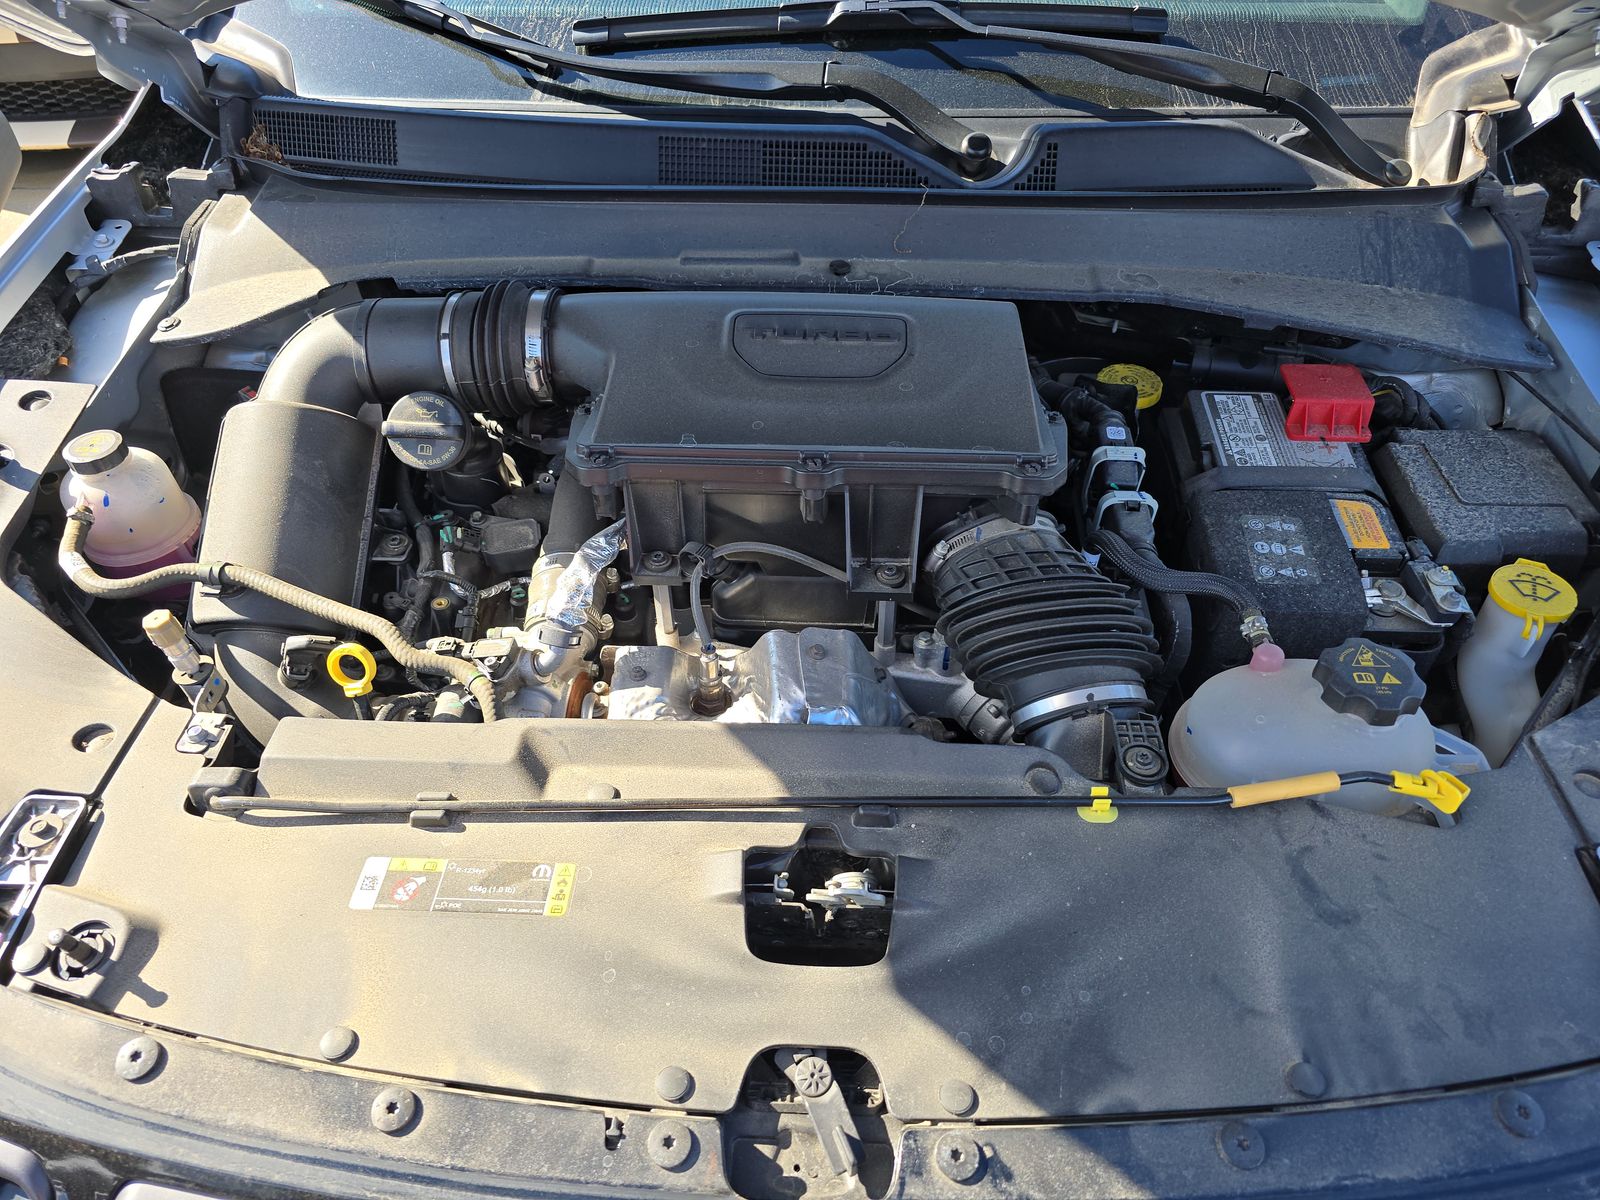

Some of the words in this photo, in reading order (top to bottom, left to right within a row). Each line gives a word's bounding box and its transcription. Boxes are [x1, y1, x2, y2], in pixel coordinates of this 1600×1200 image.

[410, 396, 434, 405] ENGINE
[435, 398, 445, 407] OIL
[468, 885, 487, 894] 454g
[488, 886, 504, 894] (1.0
[505, 886, 516, 894] lb)
